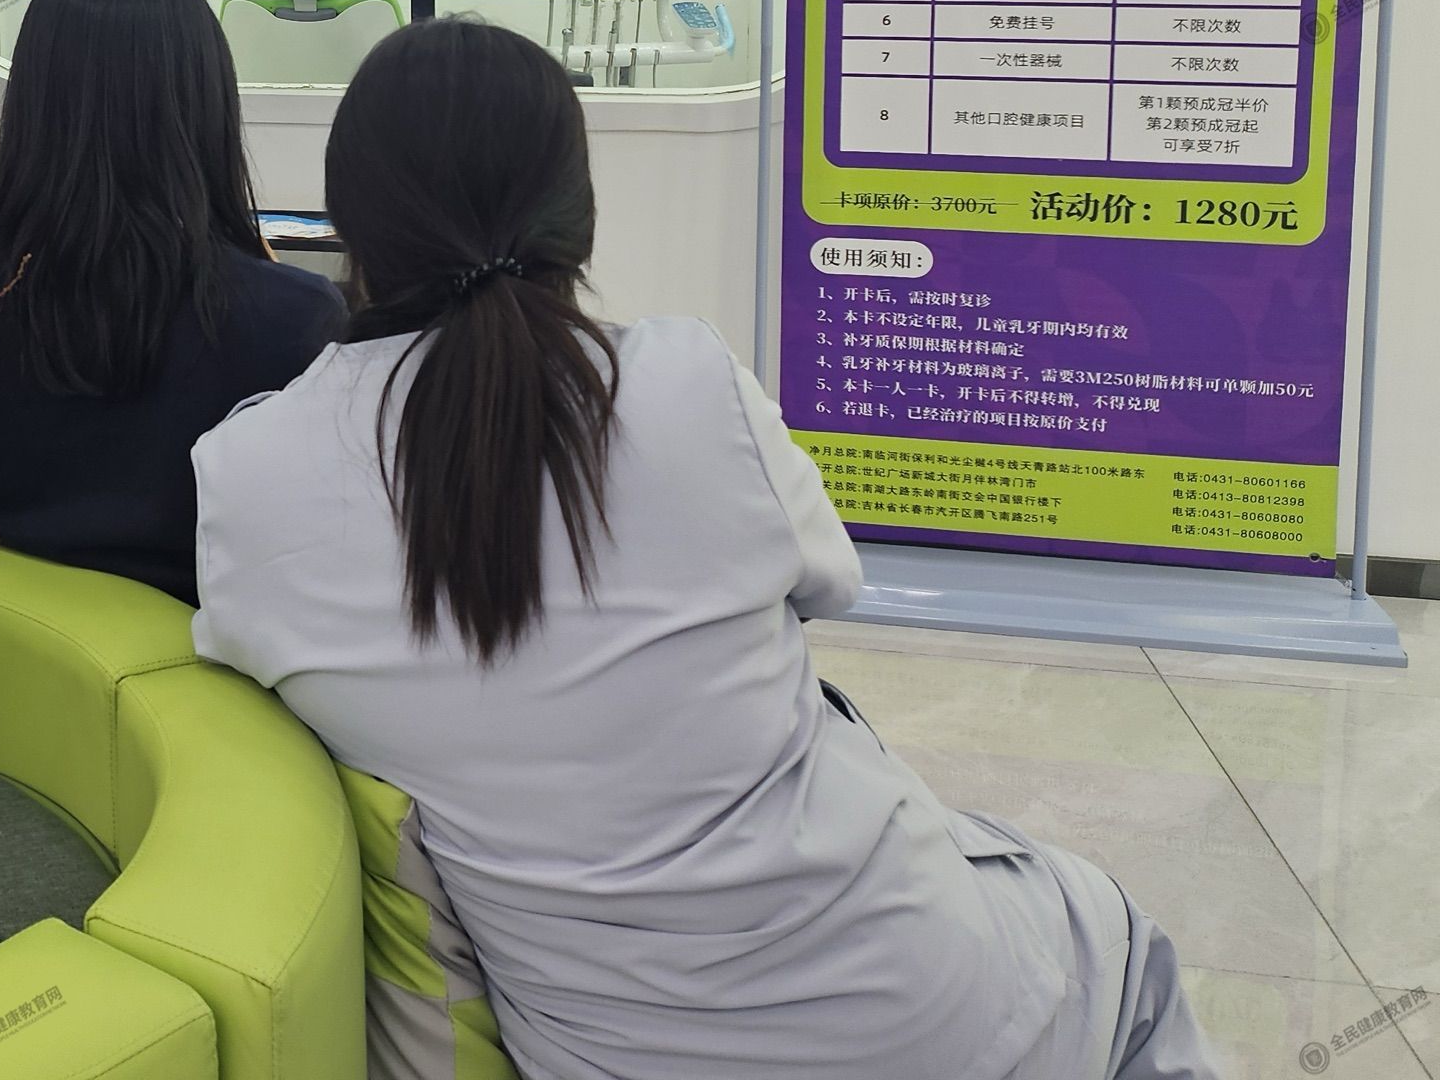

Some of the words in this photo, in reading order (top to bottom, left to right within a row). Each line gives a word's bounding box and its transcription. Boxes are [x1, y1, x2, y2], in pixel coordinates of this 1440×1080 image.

[882, 14, 891, 26] 6
[989, 15, 1056, 31] 免费挂号
[1172, 18, 1242, 34] 不限次数
[881, 51, 890, 63] 7
[979, 53, 1063, 69] 一次性器械
[1171, 56, 1239, 73] 不限次数
[1138, 95, 1269, 114] 第1颗预成冠半价
[879, 109, 889, 121] 8
[953, 110, 1085, 129] 其他口腔健康项目
[1145, 115, 1259, 134] 第2颗预成冠起
[1163, 137, 1241, 155] 可享受7折
[1029, 190, 1299, 232] 活动价：1280元
[820, 247, 924, 270] 使用须知：
[816, 332, 1025, 357] 3、补牙质保期根据材料确定
[815, 463, 1037, 489] 开总院:世纪广场新城大街月伴林湾门市
[1172, 489, 1305, 507] 电话:0413-80812398
[1173, 471, 1306, 489] 电话:0431-80601166
[829, 498, 1059, 525] 总院:吉林省长春市汽开区腾飞南路251号
[1171, 524, 1303, 542] 电话:0431-80608000
[1171, 506, 1304, 524] 电话:0431-80608080
